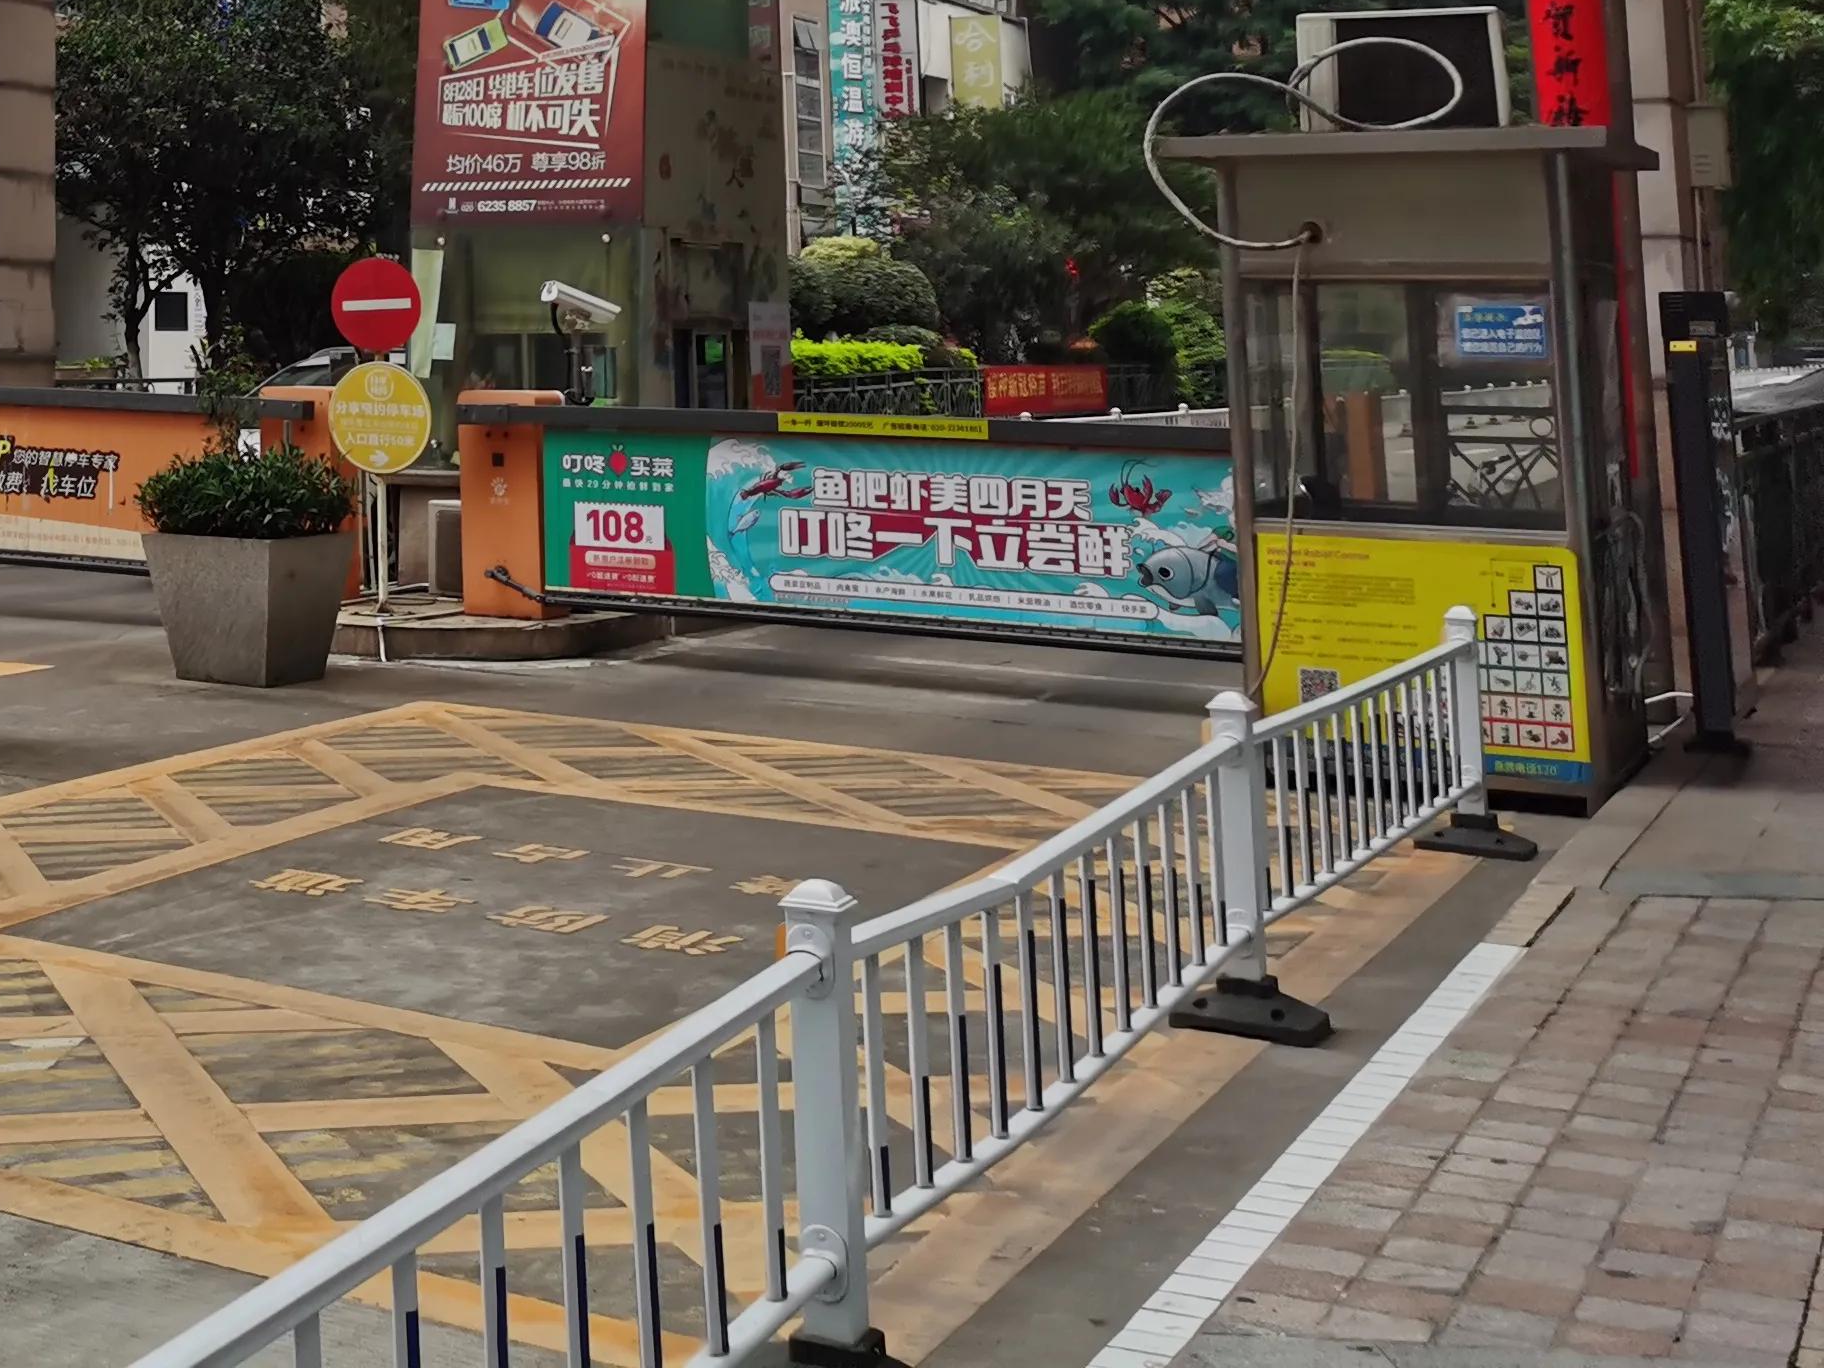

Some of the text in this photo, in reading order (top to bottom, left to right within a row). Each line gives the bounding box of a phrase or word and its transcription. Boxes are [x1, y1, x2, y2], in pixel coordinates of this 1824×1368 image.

[443, 59, 605, 103] 8月28日 华港车位发售
[506, 98, 601, 138] 机不可失
[446, 151, 606, 175] 均价46万 尊享98折
[477, 199, 507, 212] 6235
[507, 199, 537, 212] 8857
[12, 448, 119, 471] 您的智慧停车专家
[812, 467, 1093, 522] 鱼肥虾美四月天
[779, 508, 1131, 577] 叮咚一下立尝鲜
